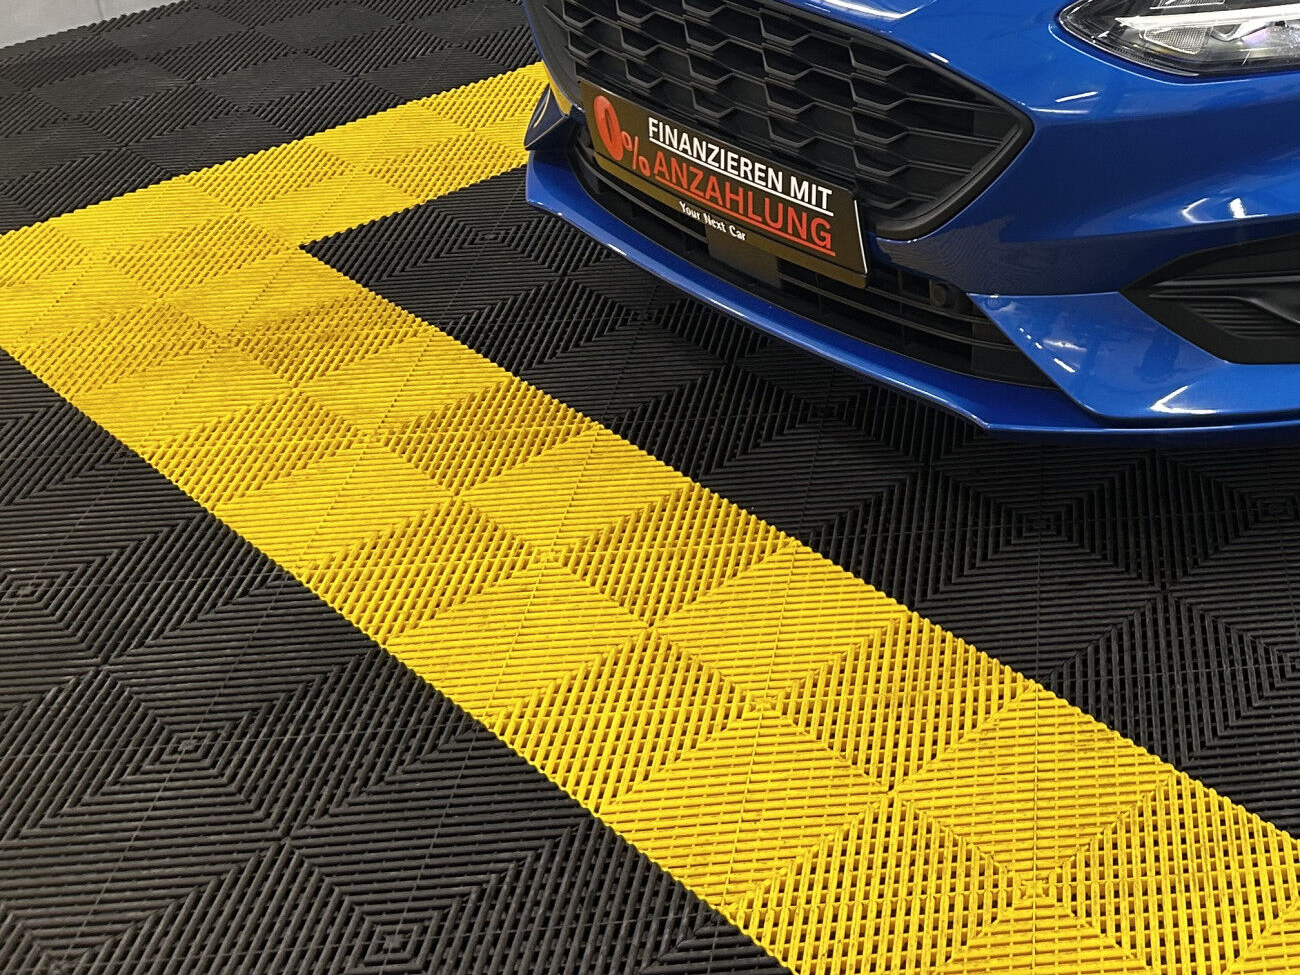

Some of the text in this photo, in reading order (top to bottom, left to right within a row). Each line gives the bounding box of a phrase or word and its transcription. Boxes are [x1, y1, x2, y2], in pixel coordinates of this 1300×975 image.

[648, 117, 833, 211] FINANZIEREN MIT
[653, 152, 832, 250] ANZAHLUNG
[679, 200, 746, 241] Your Next Car
